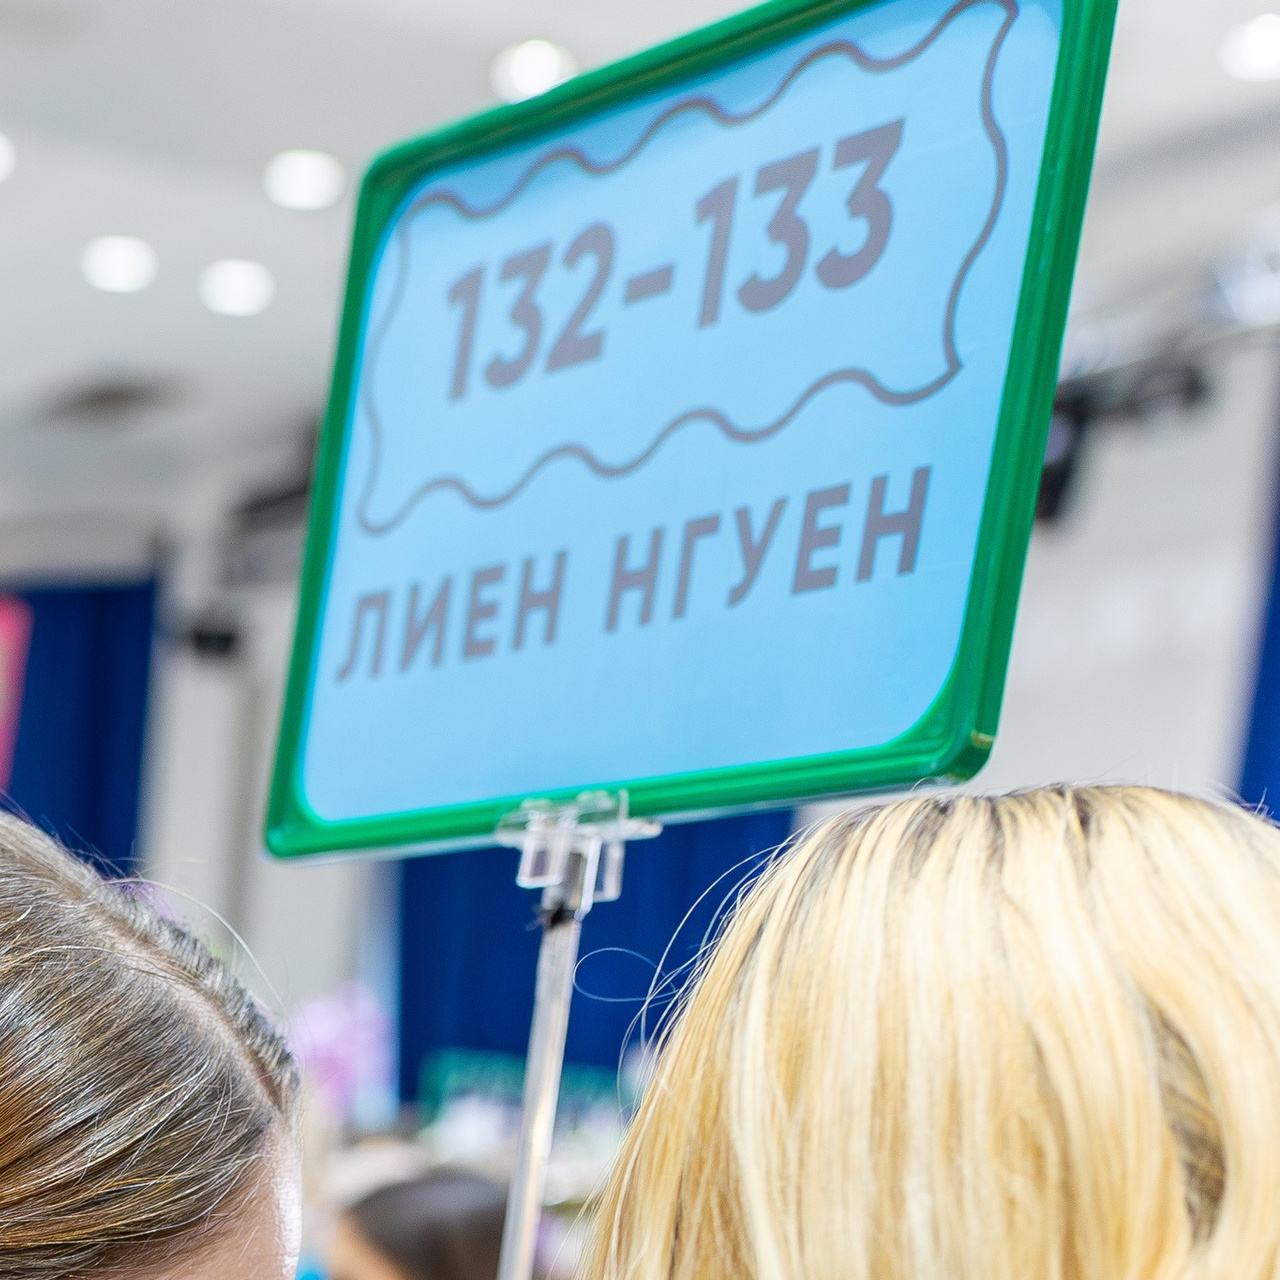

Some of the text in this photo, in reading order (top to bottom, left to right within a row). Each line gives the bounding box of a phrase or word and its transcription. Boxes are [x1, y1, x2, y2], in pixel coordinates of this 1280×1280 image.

[446, 118, 906, 402] 132-133
[336, 466, 933, 684] ЛИЕН НГУЕН
